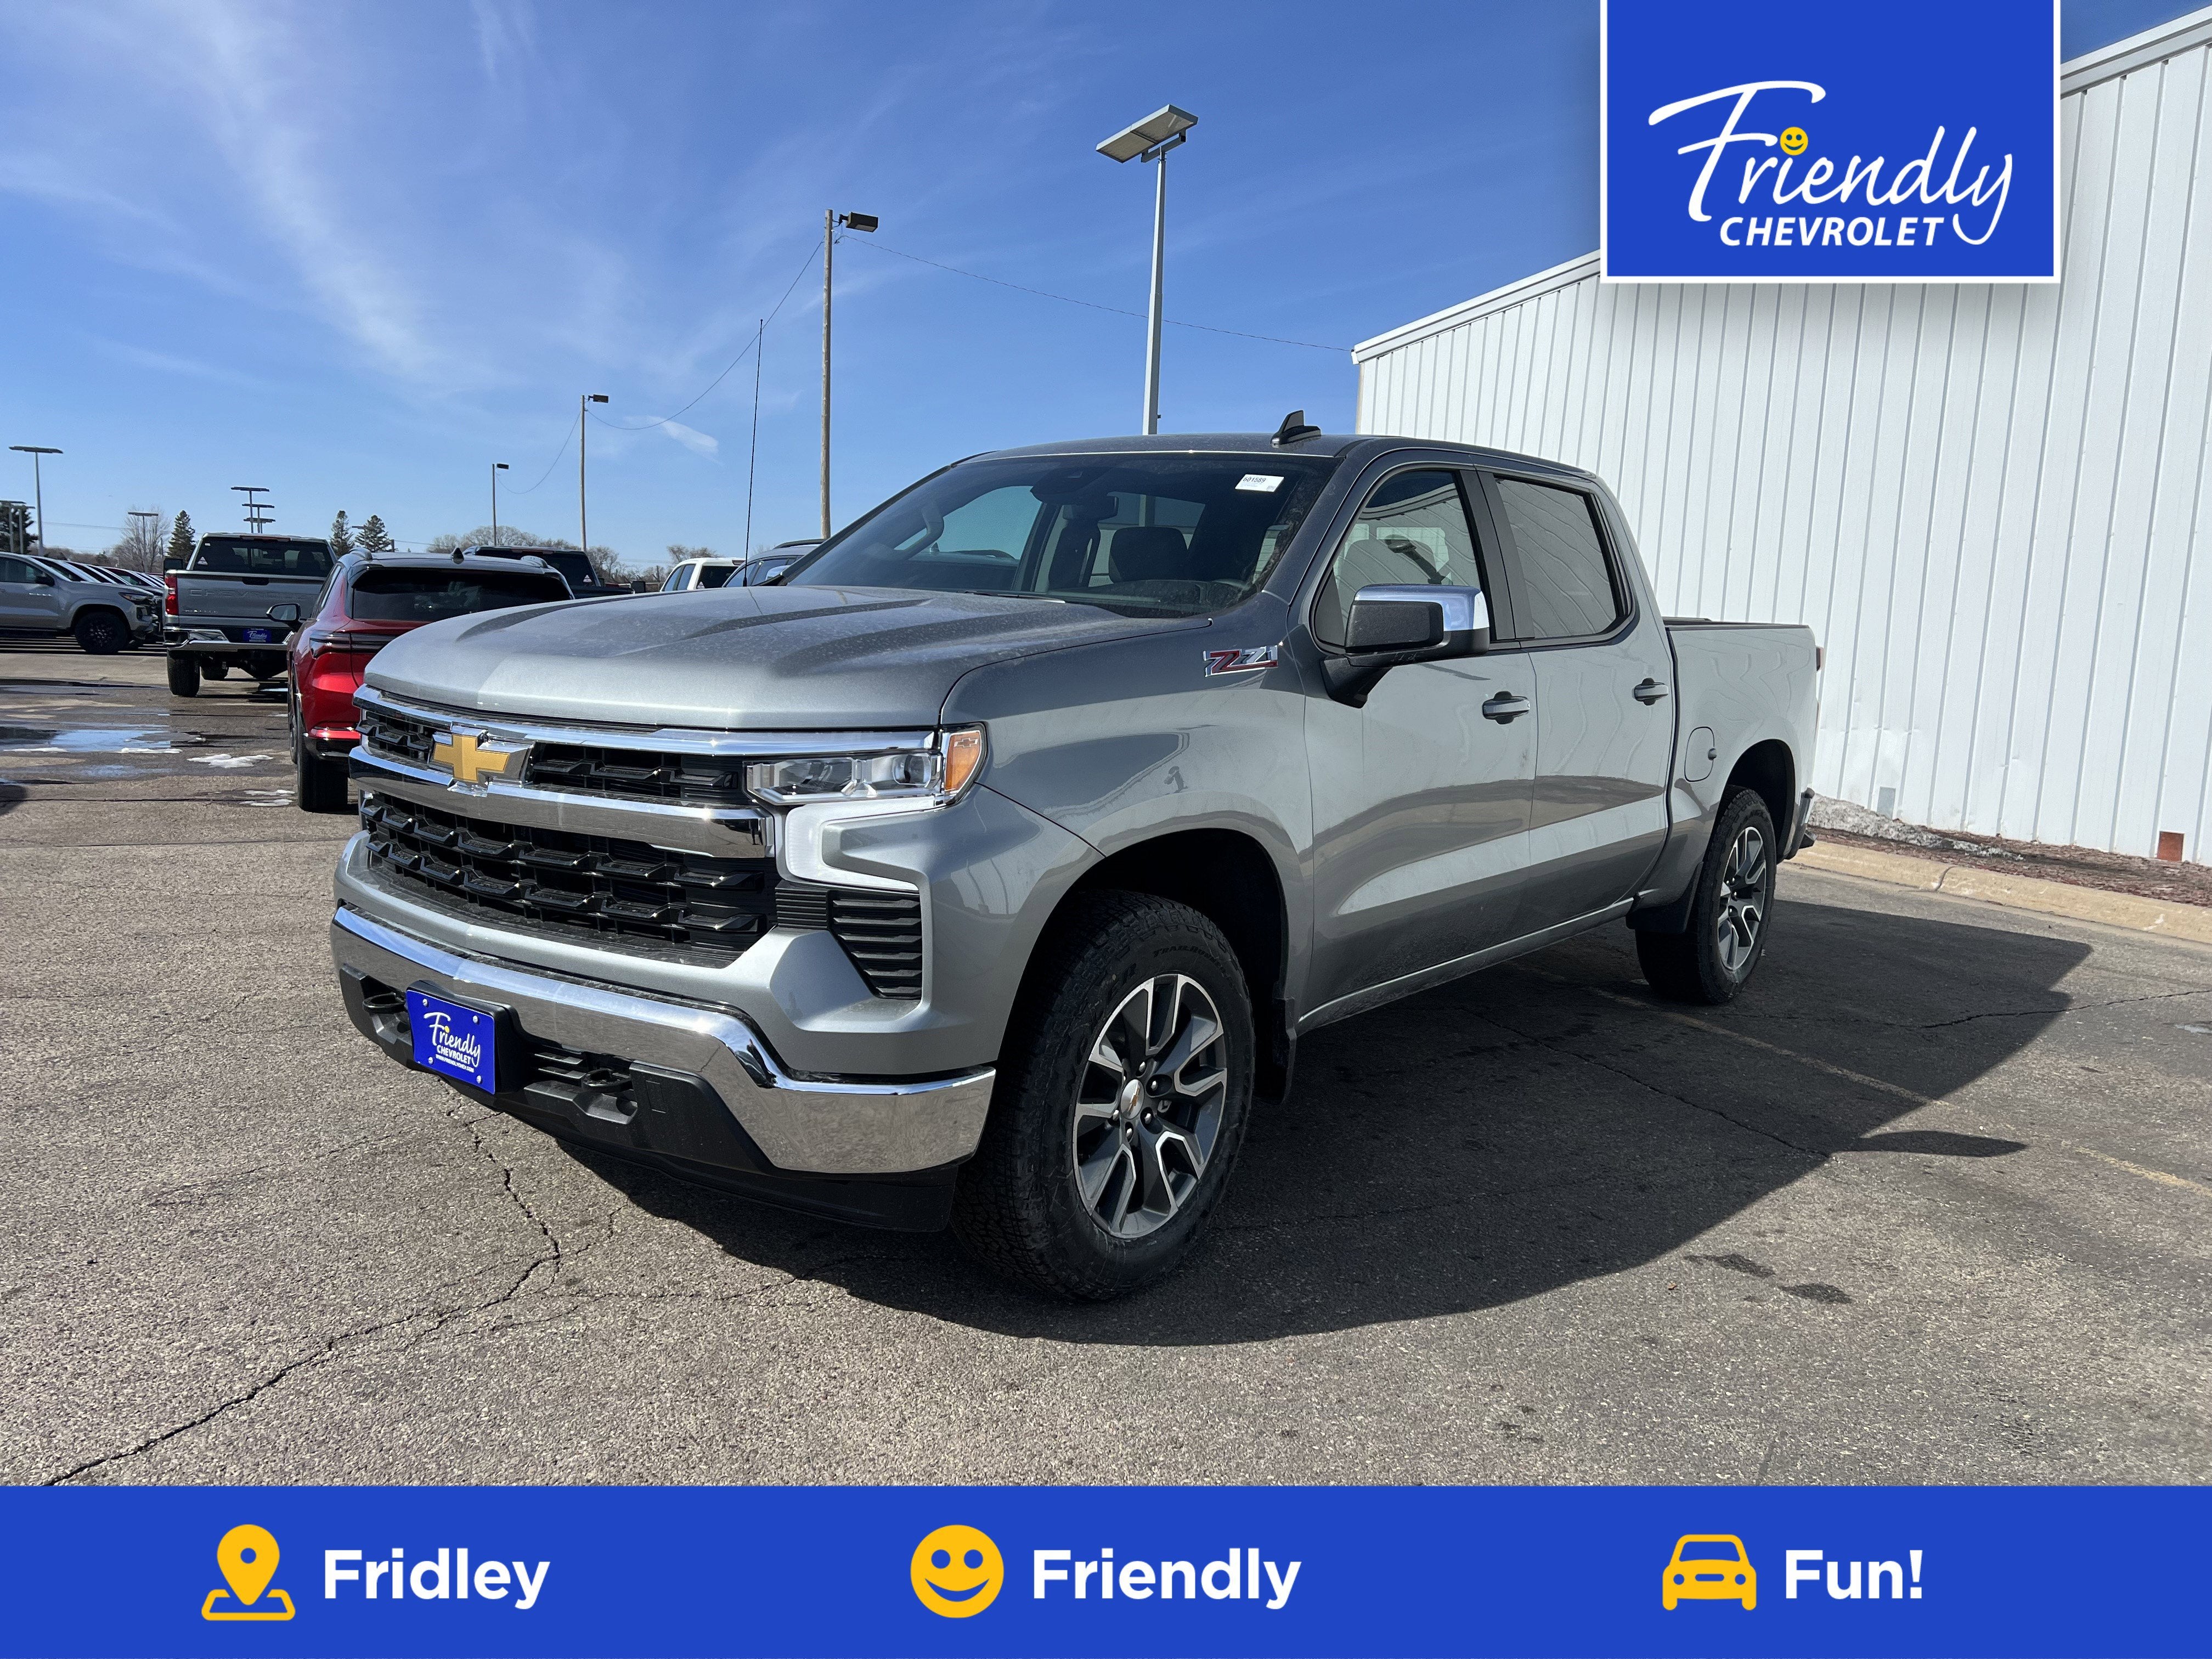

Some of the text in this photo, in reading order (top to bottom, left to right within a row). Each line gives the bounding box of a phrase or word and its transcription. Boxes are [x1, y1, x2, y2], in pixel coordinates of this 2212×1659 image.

[1203, 645, 1278, 677] Z71
[424, 1012, 481, 1068] Friendly
[437, 1045, 472, 1065] CHEVROLET
